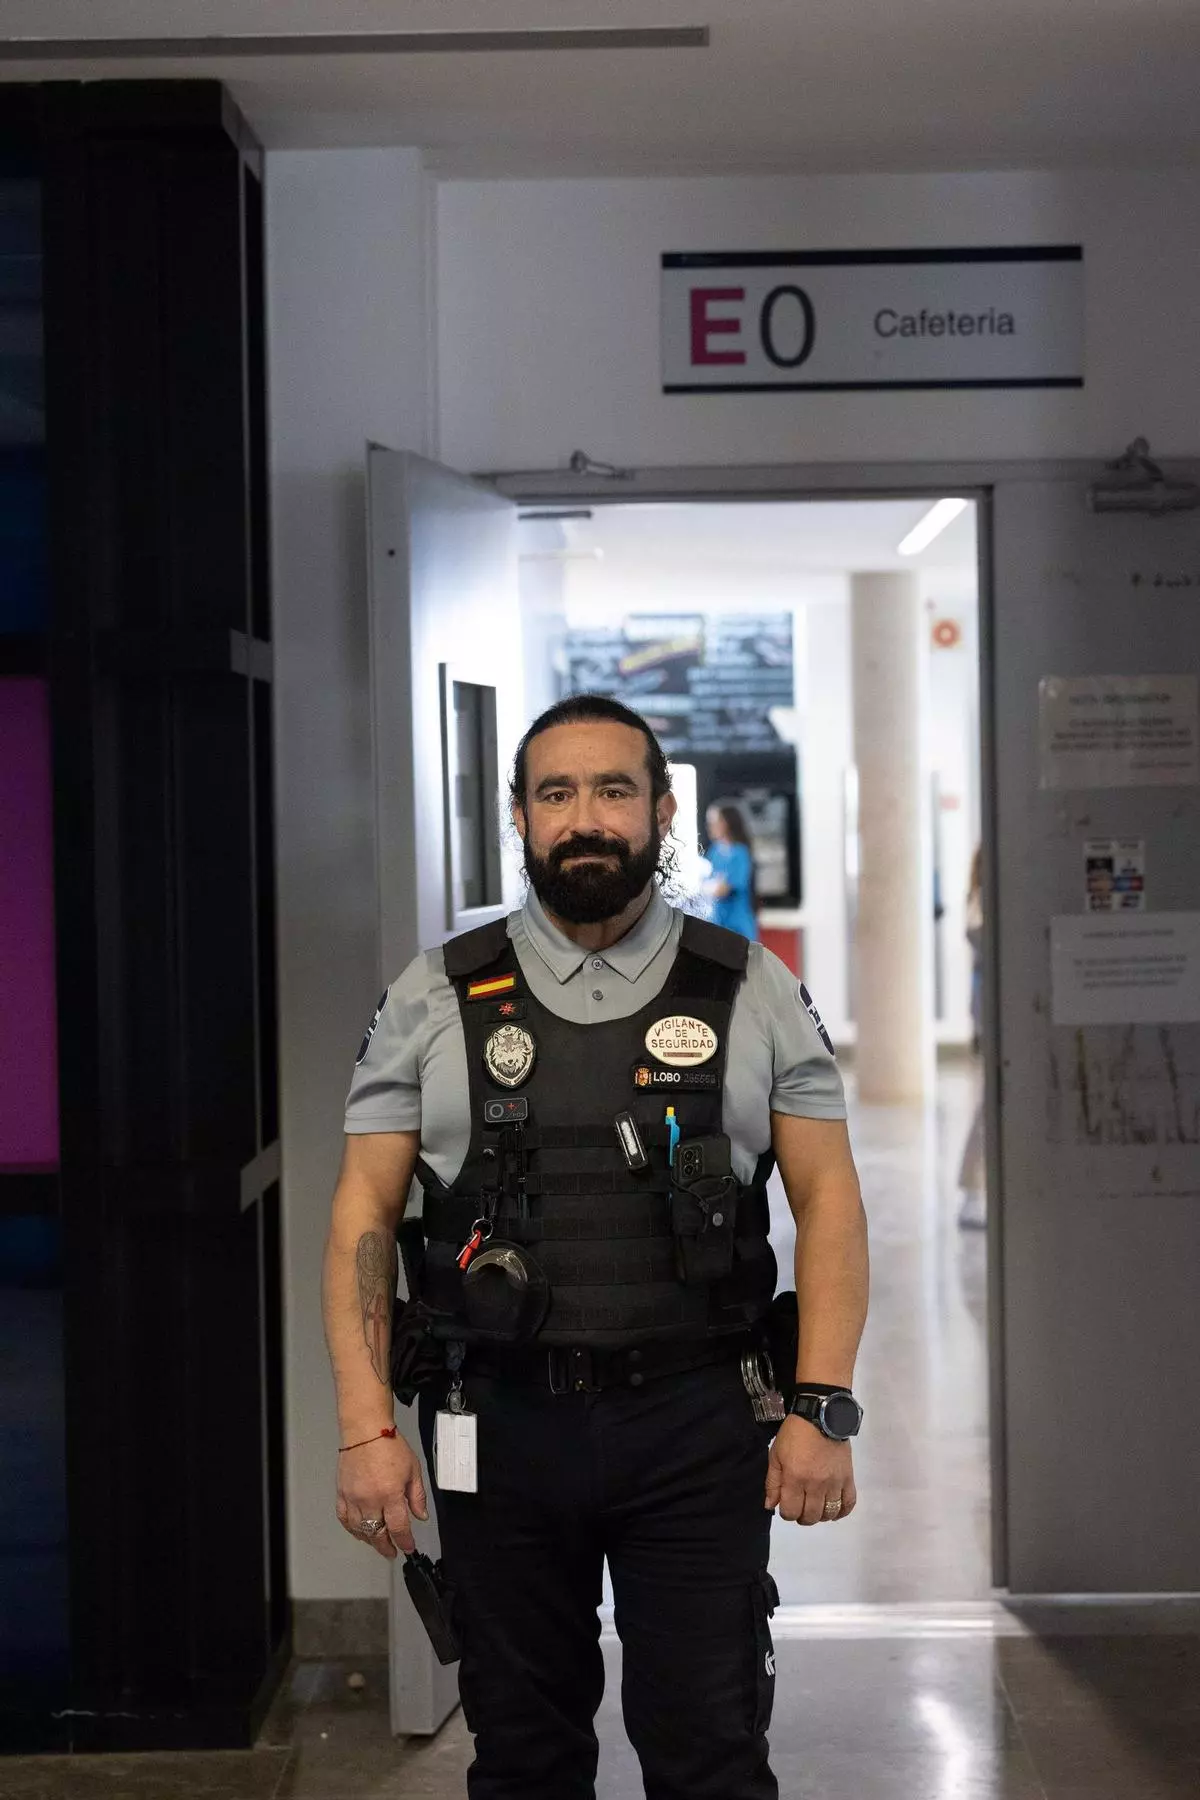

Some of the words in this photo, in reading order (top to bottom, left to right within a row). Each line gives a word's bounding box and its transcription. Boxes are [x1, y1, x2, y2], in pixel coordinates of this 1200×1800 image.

[873, 308, 1016, 338] Cafeteria
[654, 1018, 709, 1038] VIGILANTE
[674, 1029, 688, 1038] DE
[651, 1039, 714, 1049] SEGURIDAD
[653, 1072, 681, 1082] LOBO
